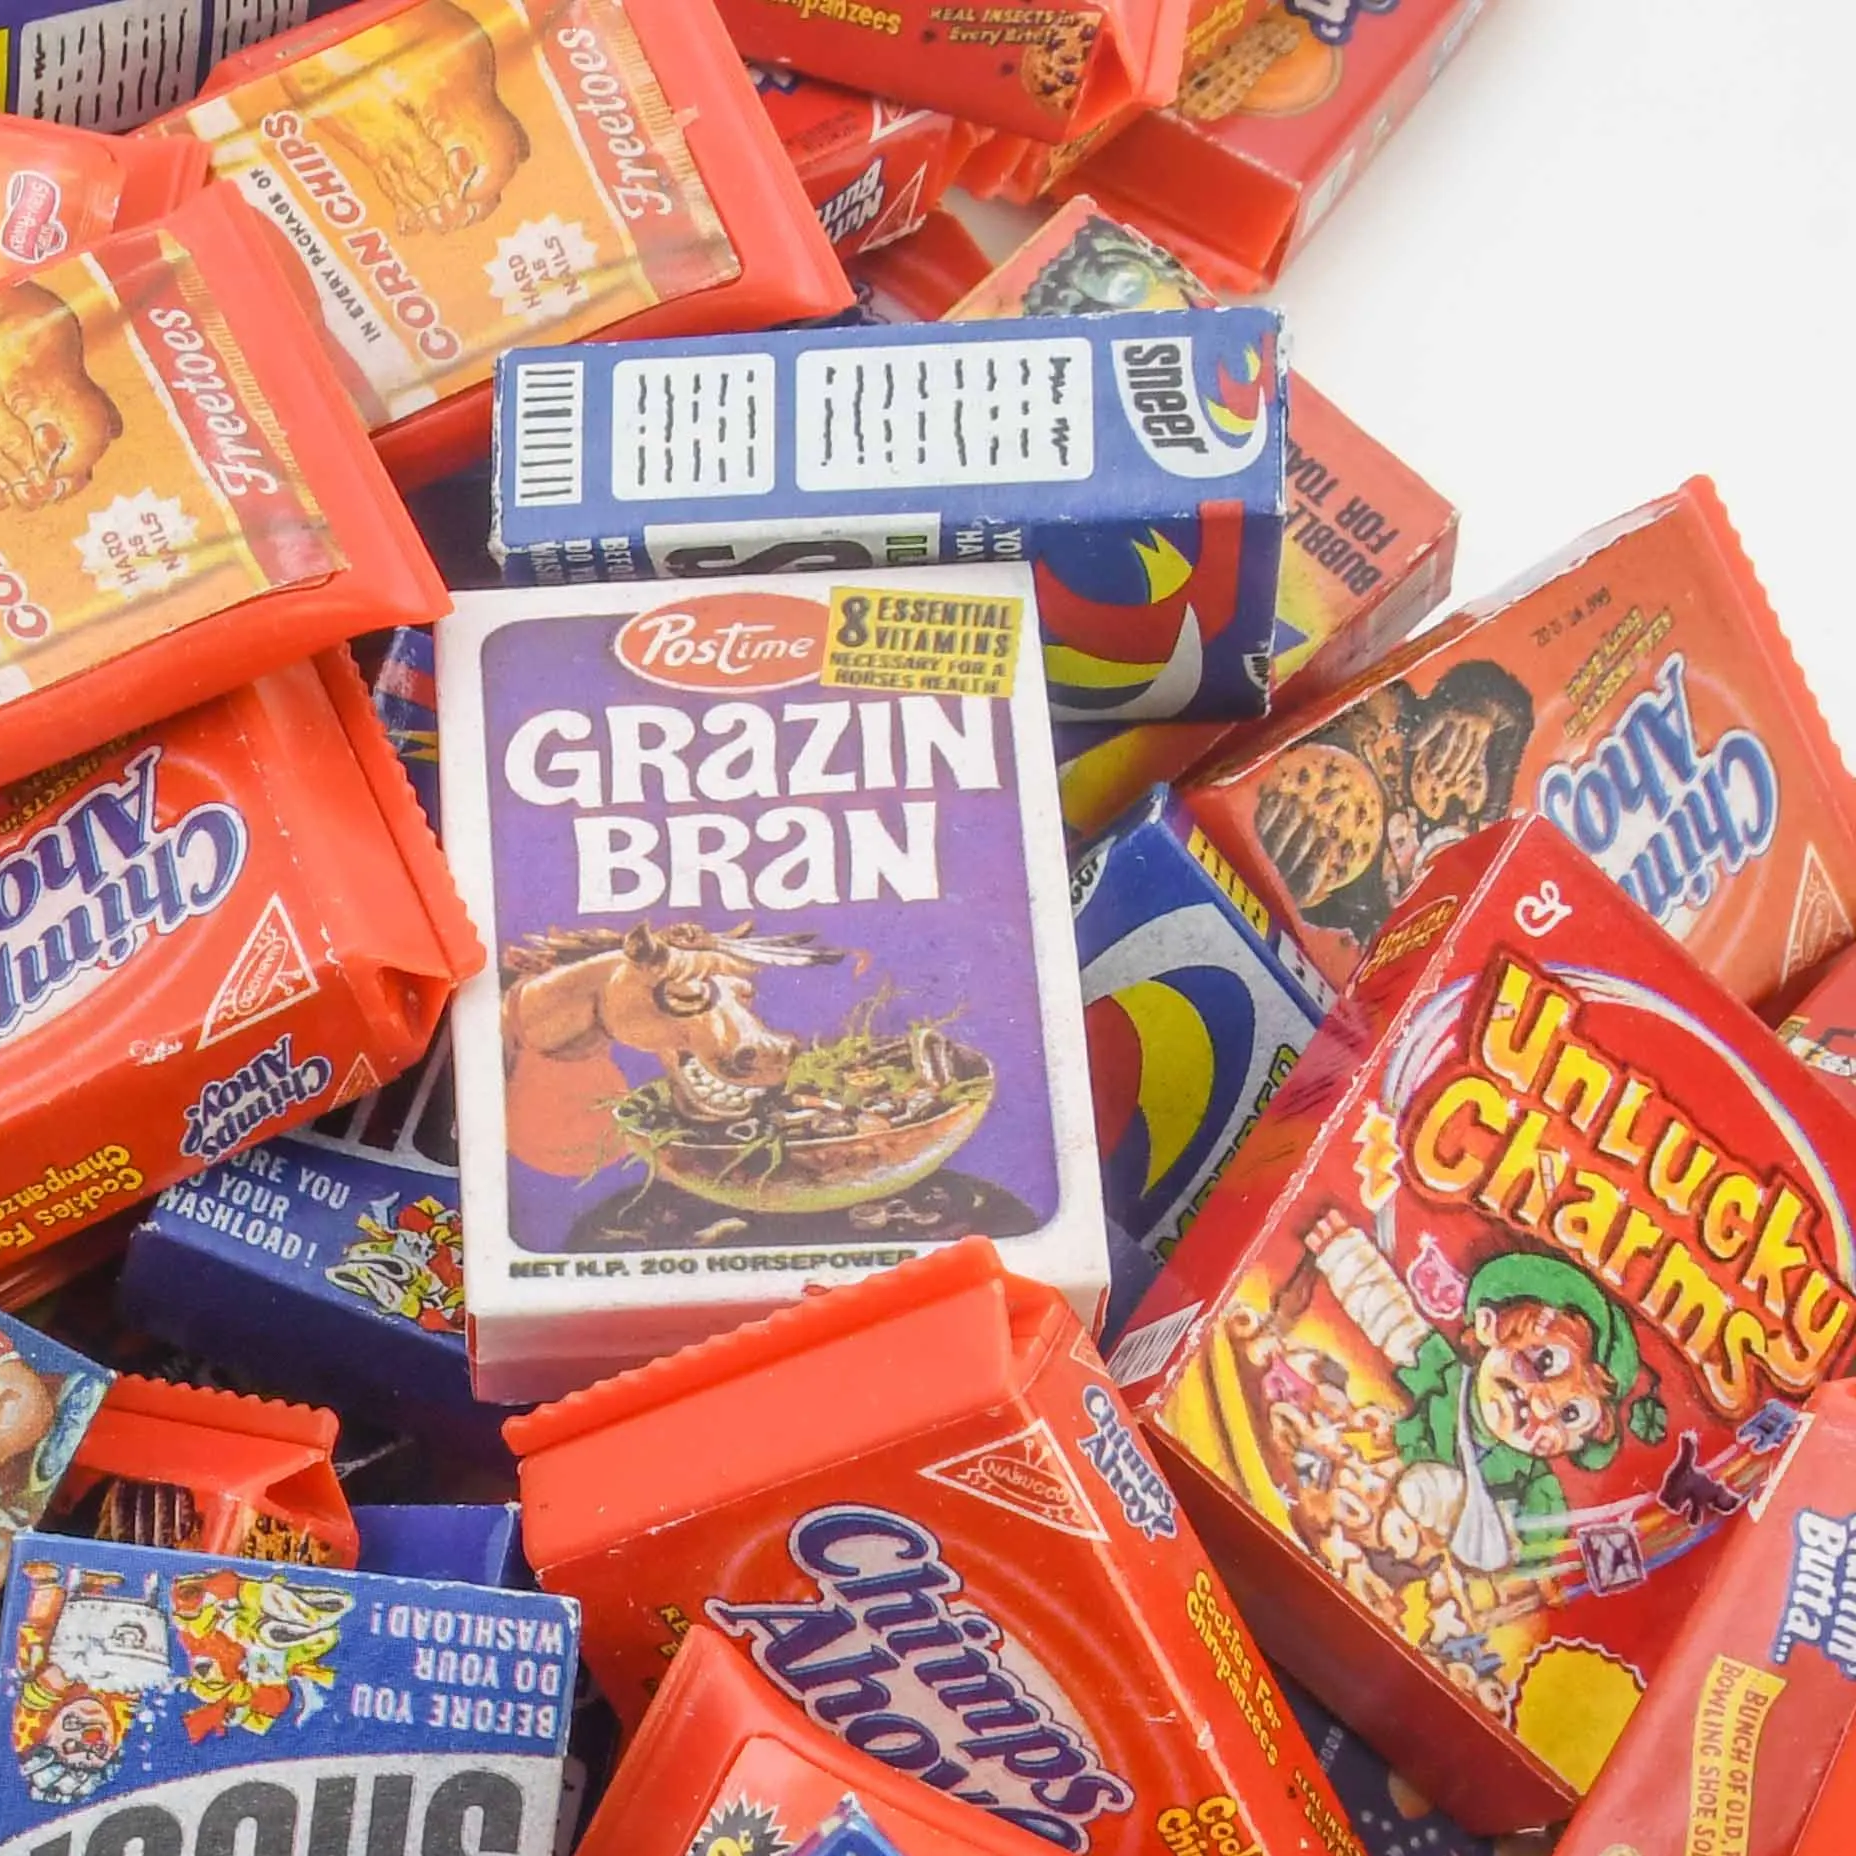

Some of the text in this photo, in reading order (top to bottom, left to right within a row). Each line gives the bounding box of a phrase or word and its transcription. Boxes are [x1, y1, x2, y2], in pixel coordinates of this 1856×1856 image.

[264, 112, 459, 360] CORN CHIPS
[359, 322, 382, 344] IN
[1122, 343, 1208, 457] sneer
[1335, 496, 1400, 555] FOR
[838, 595, 1012, 646] 8 ESSENTIAL
[875, 627, 1011, 658] VITAMINS
[829, 651, 940, 674] NECESSARY
[199, 1056, 331, 1162] Chimps
[41, 1165, 144, 1229] Cookies
[219, 1175, 290, 1222] YOUR
[509, 1247, 921, 1280] NET 200 HORSEPOWER
[1412, 1074, 1770, 1411] Charms
[370, 1604, 565, 1657] WASHLOAD!
[1194, 1569, 1283, 1732] Cookies For
[417, 1649, 561, 1695] DO YOUR
[796, 1509, 1131, 1818] Chimps
[1185, 1588, 1280, 1769] Chimpanzees
[350, 1685, 557, 1740] BEFORE YOU
[1698, 1660, 1746, 1759] BOWLING
[1695, 1762, 1723, 1819] SHOE
